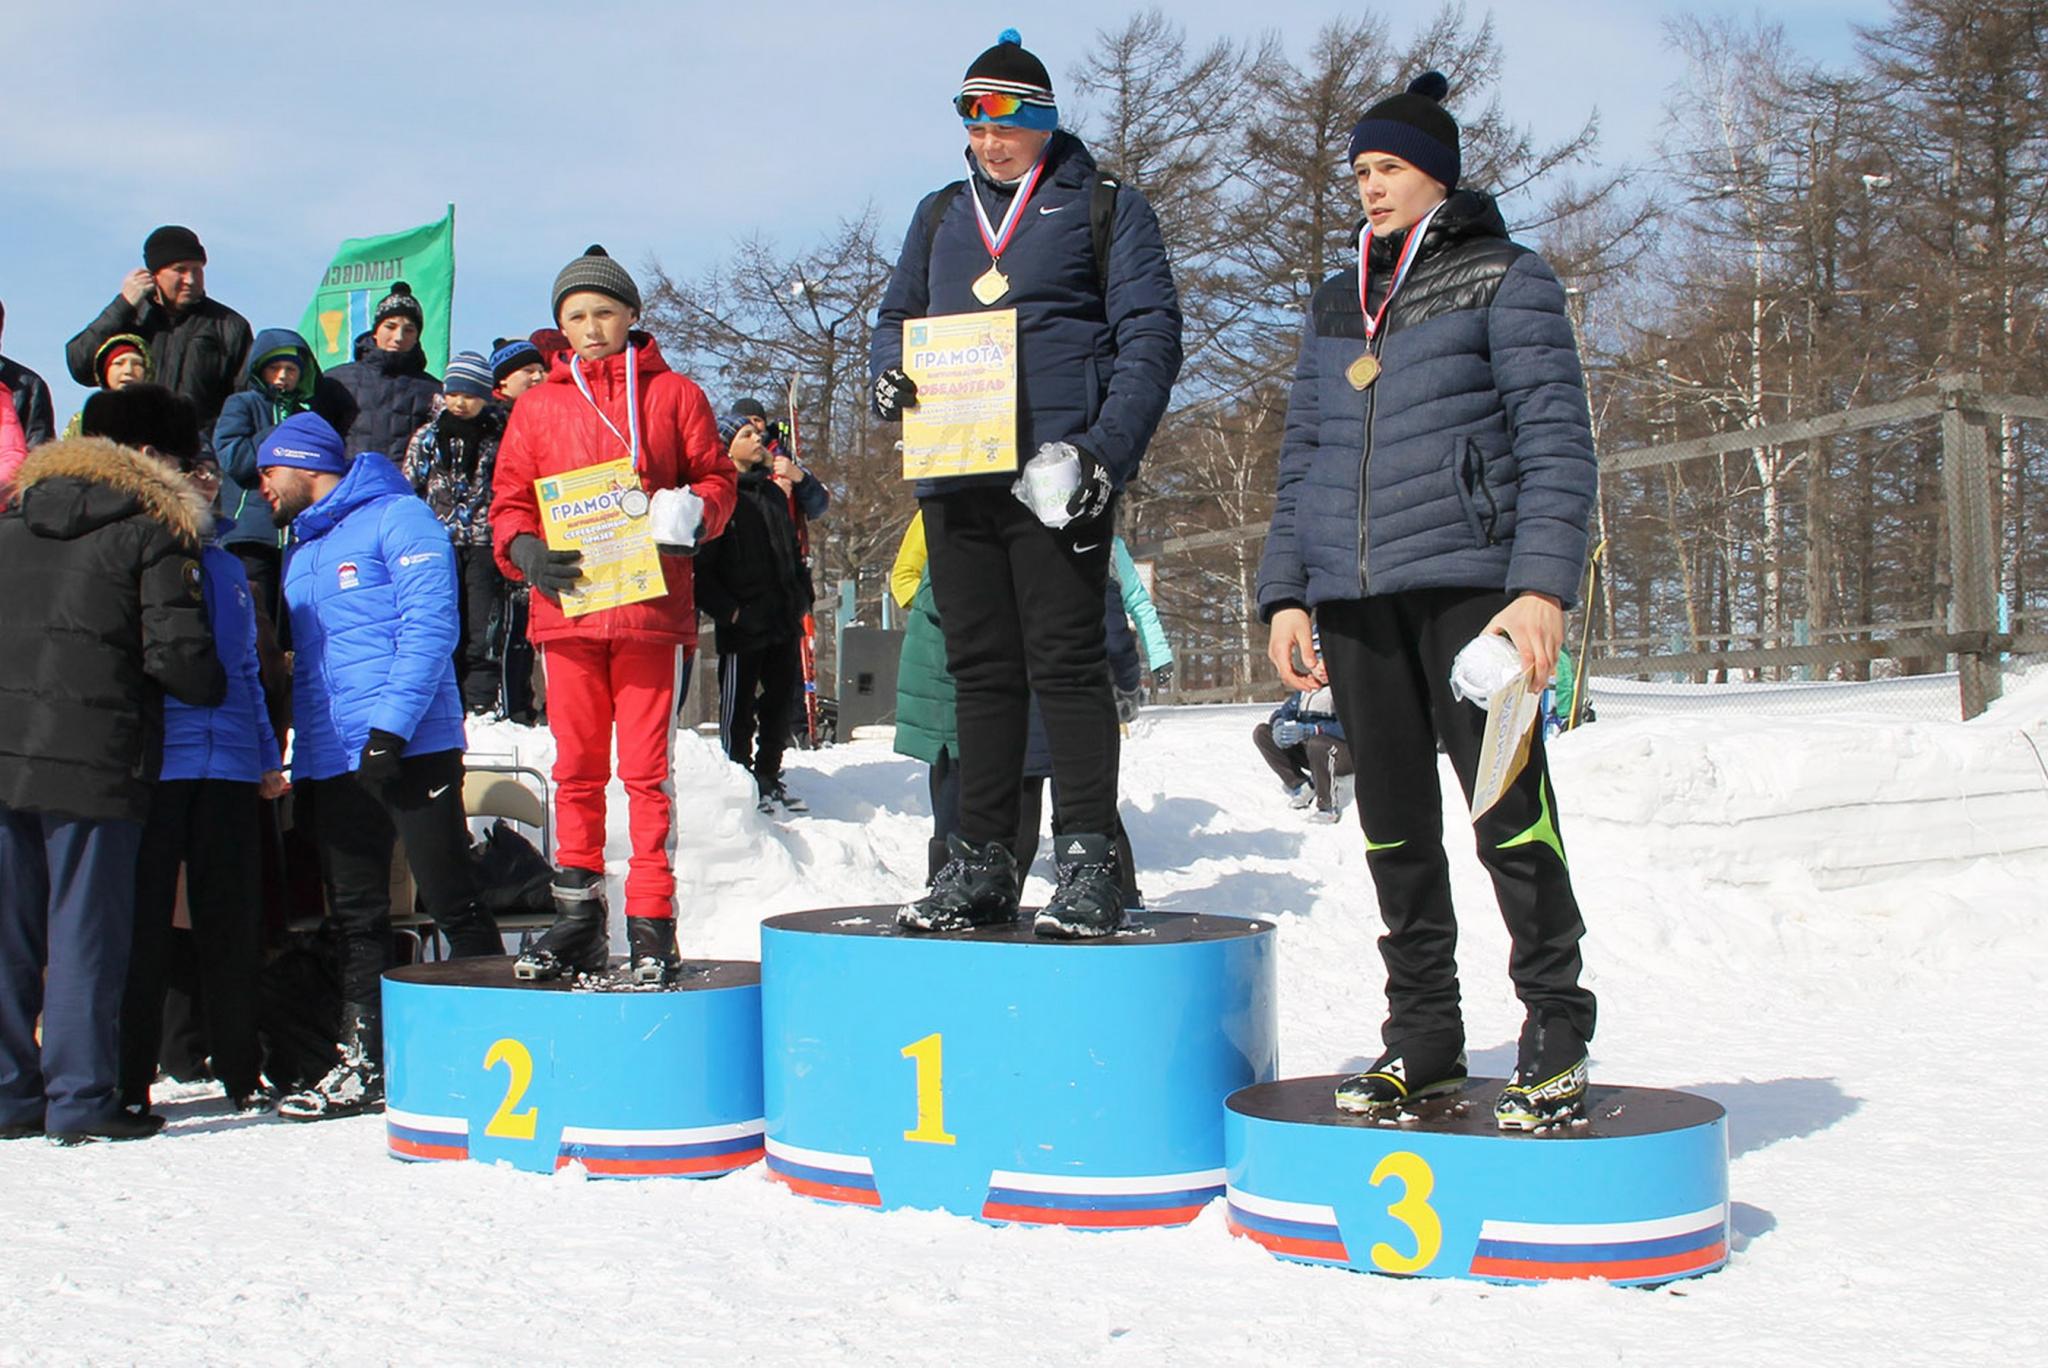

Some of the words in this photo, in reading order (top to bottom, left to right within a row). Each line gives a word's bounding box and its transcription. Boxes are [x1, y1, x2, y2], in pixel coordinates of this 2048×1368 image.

[914, 346, 1003, 369] ГРАМОТА
[916, 379, 1006, 397] ОБЕДИТЕЛЬ
[551, 490, 628, 521] ГРАМОТ
[483, 1037, 539, 1141] 2
[900, 1031, 957, 1146] 1
[1368, 1150, 1443, 1274] 3
